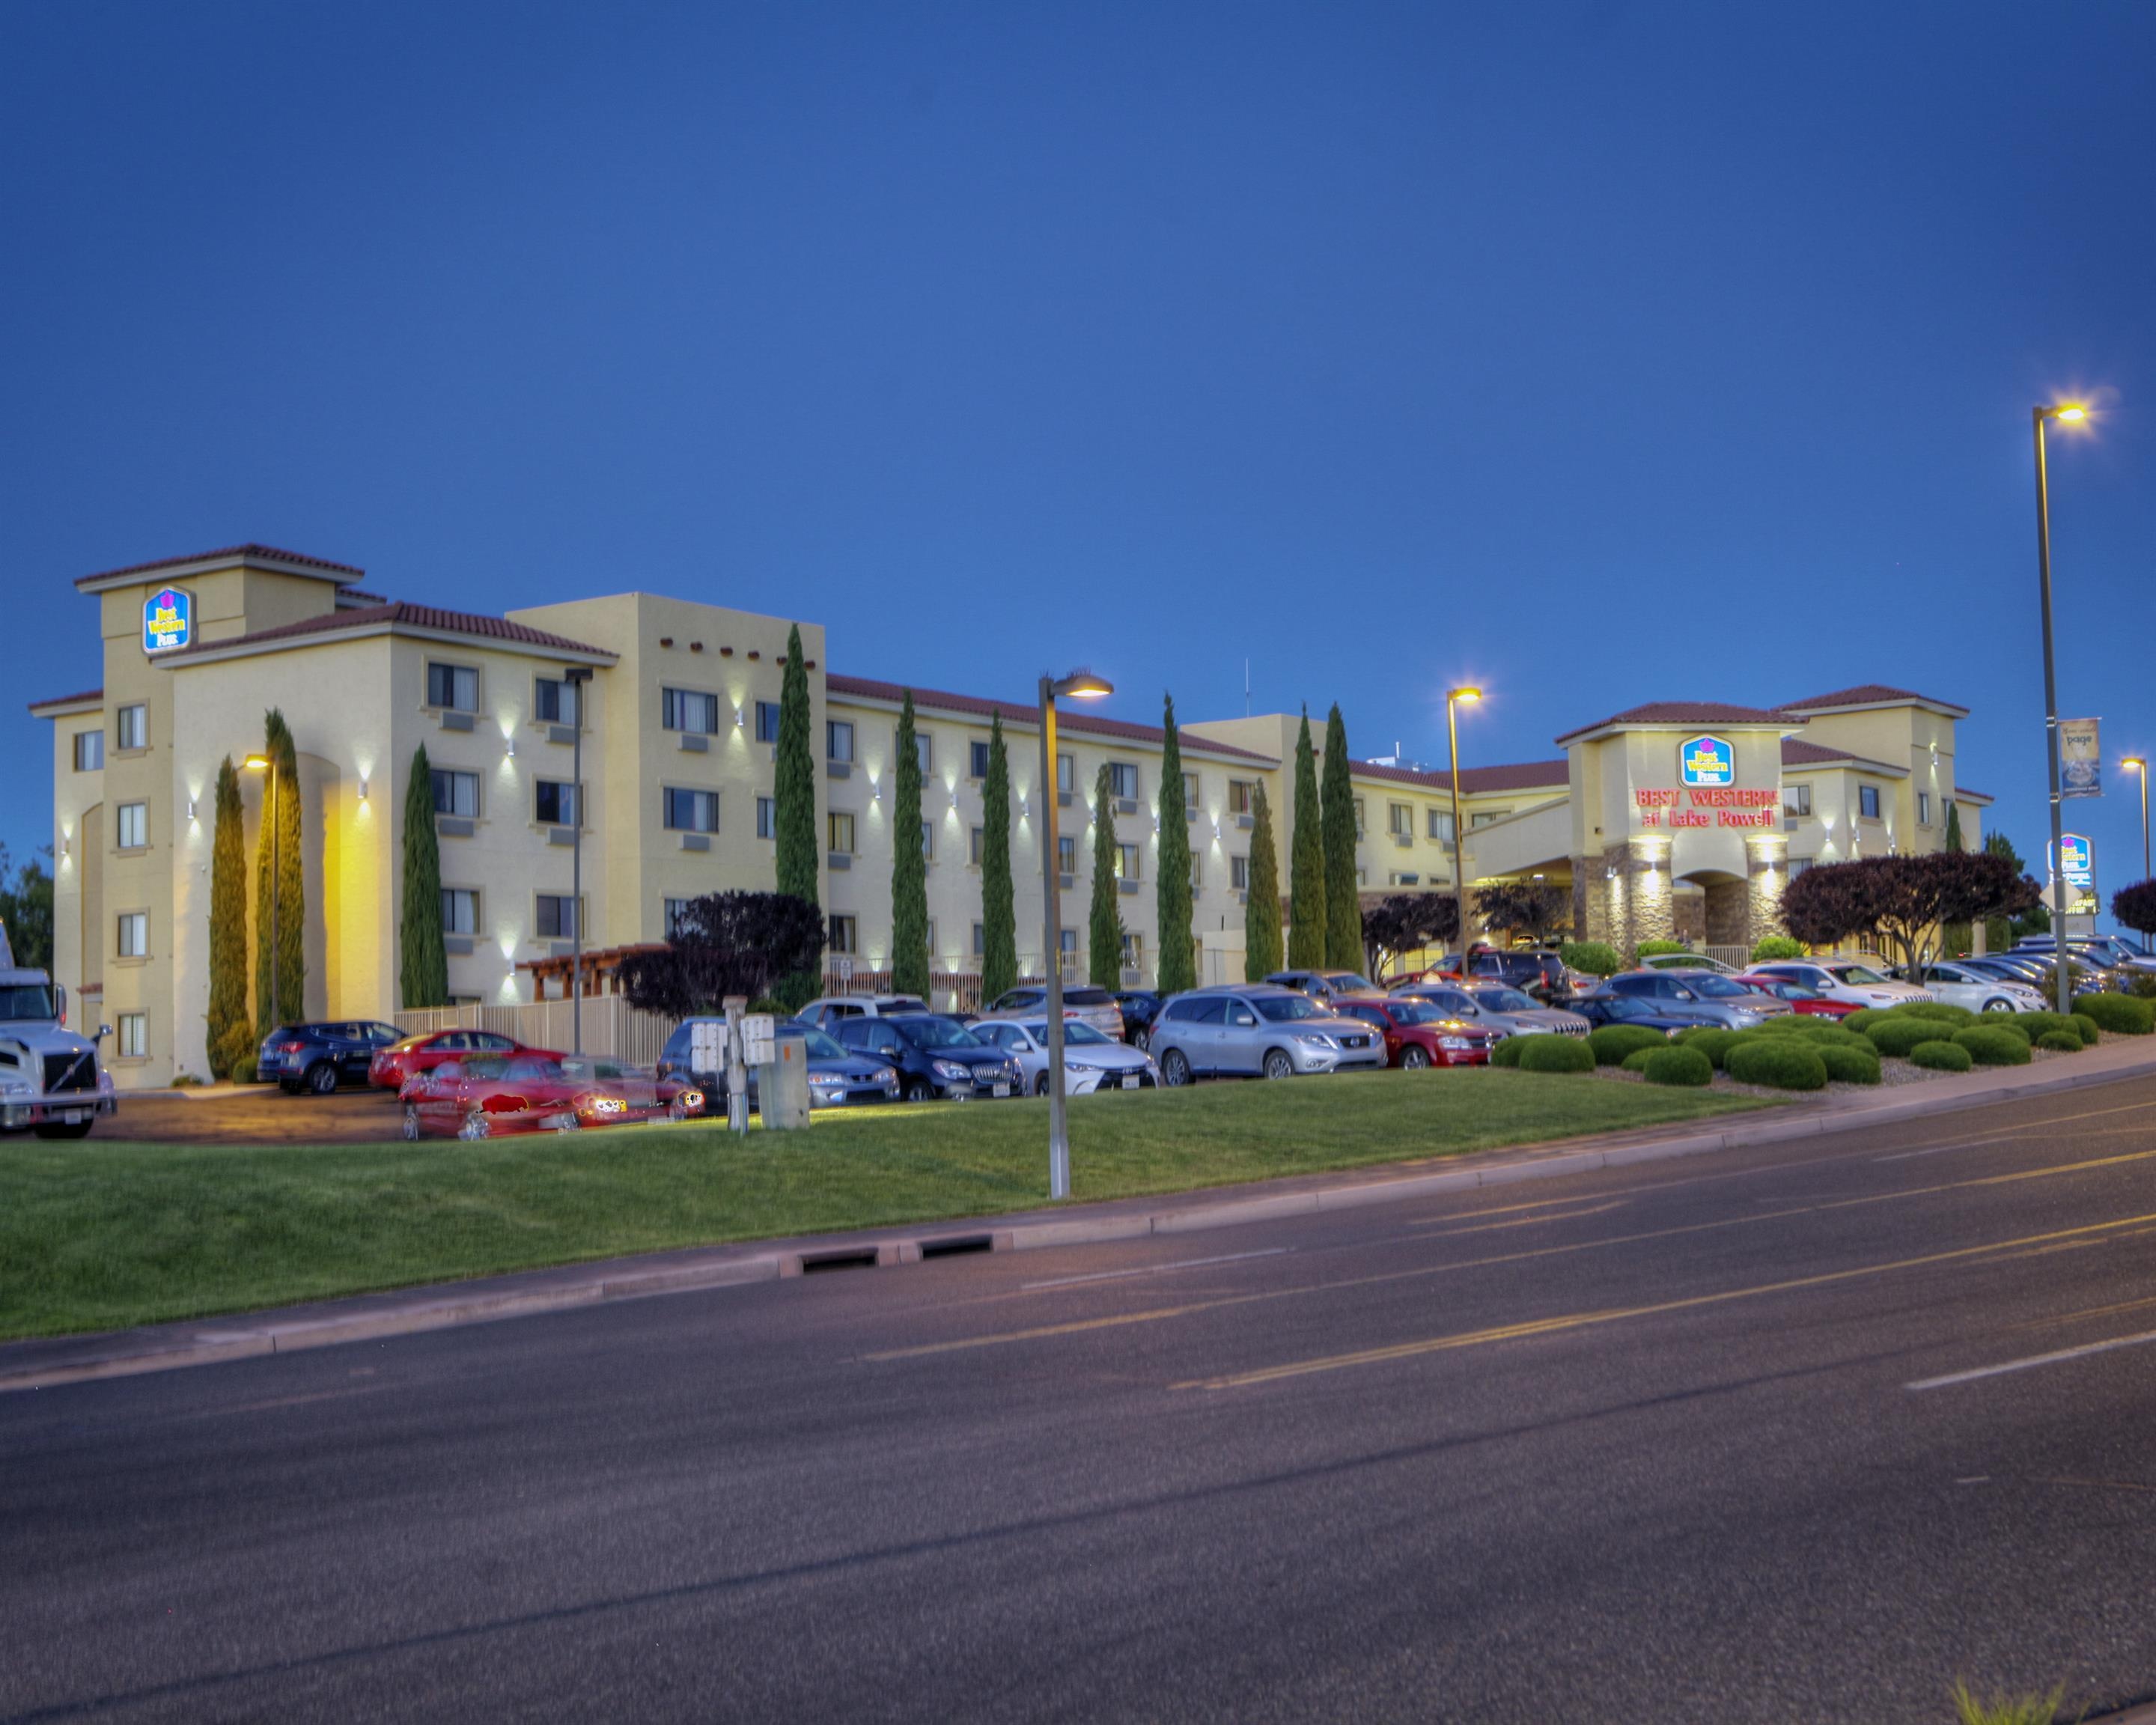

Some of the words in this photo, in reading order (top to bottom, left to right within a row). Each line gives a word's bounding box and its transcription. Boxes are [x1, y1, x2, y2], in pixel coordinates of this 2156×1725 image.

[156, 606, 177, 621] Best
[148, 618, 186, 634] Western
[1694, 751, 1718, 762] Best
[1686, 760, 1729, 772] Western
[1636, 788, 1681, 806] BEST
[1689, 788, 1779, 806] WESTERN
[1642, 810, 1660, 827] at
[1669, 809, 1710, 827] Lake
[1717, 808, 1774, 827] Powell
